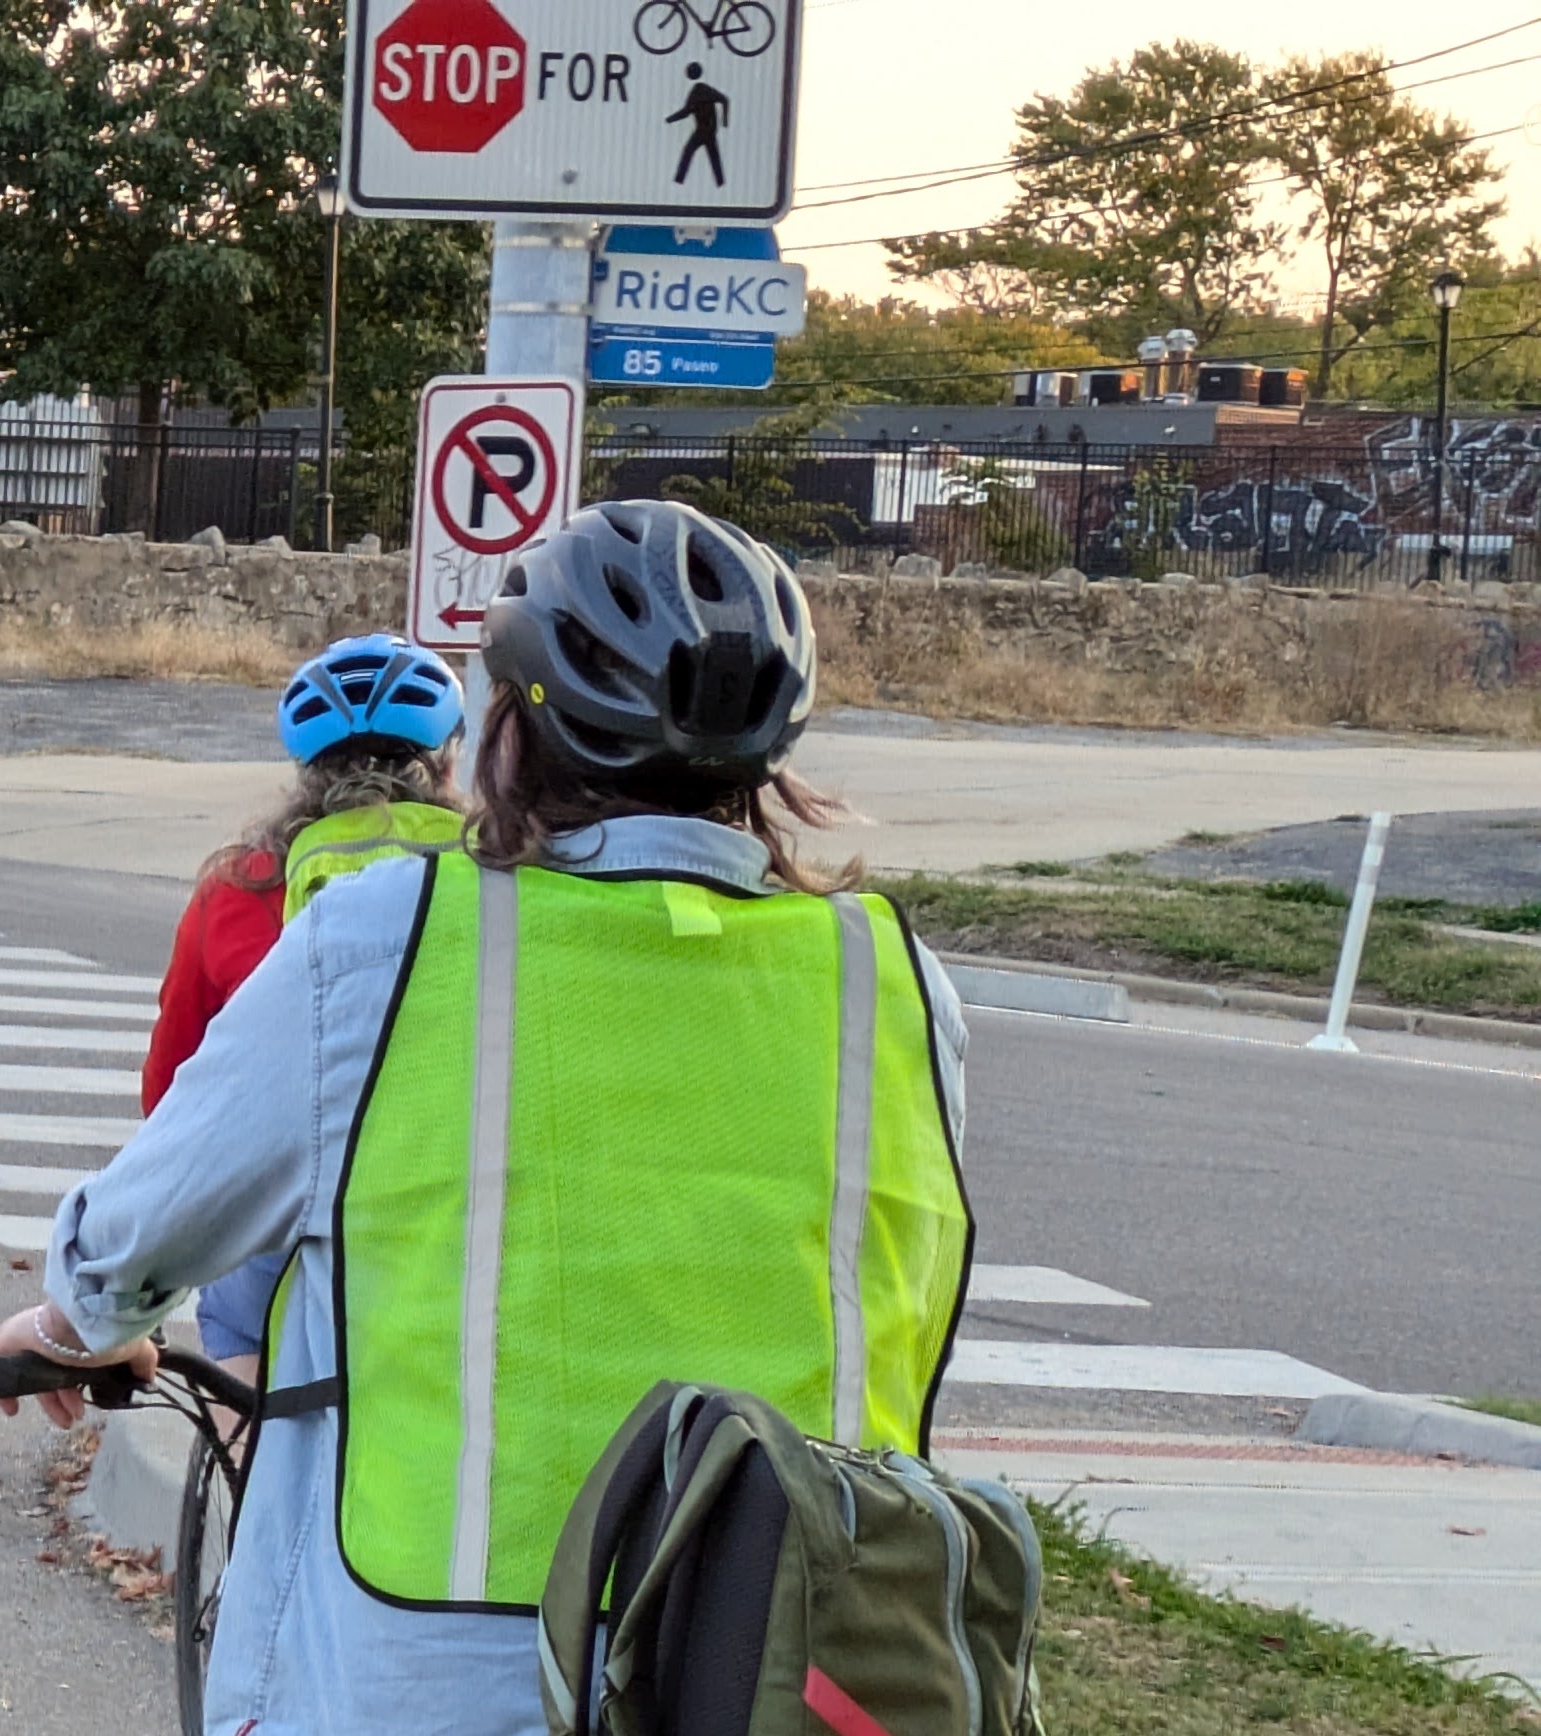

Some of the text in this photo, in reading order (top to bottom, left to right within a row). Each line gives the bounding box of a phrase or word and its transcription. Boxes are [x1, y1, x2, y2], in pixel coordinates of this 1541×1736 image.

[378, 43, 631, 104] STOP FOR
[615, 270, 790, 316] RideKC
[623, 350, 662, 375] 85
